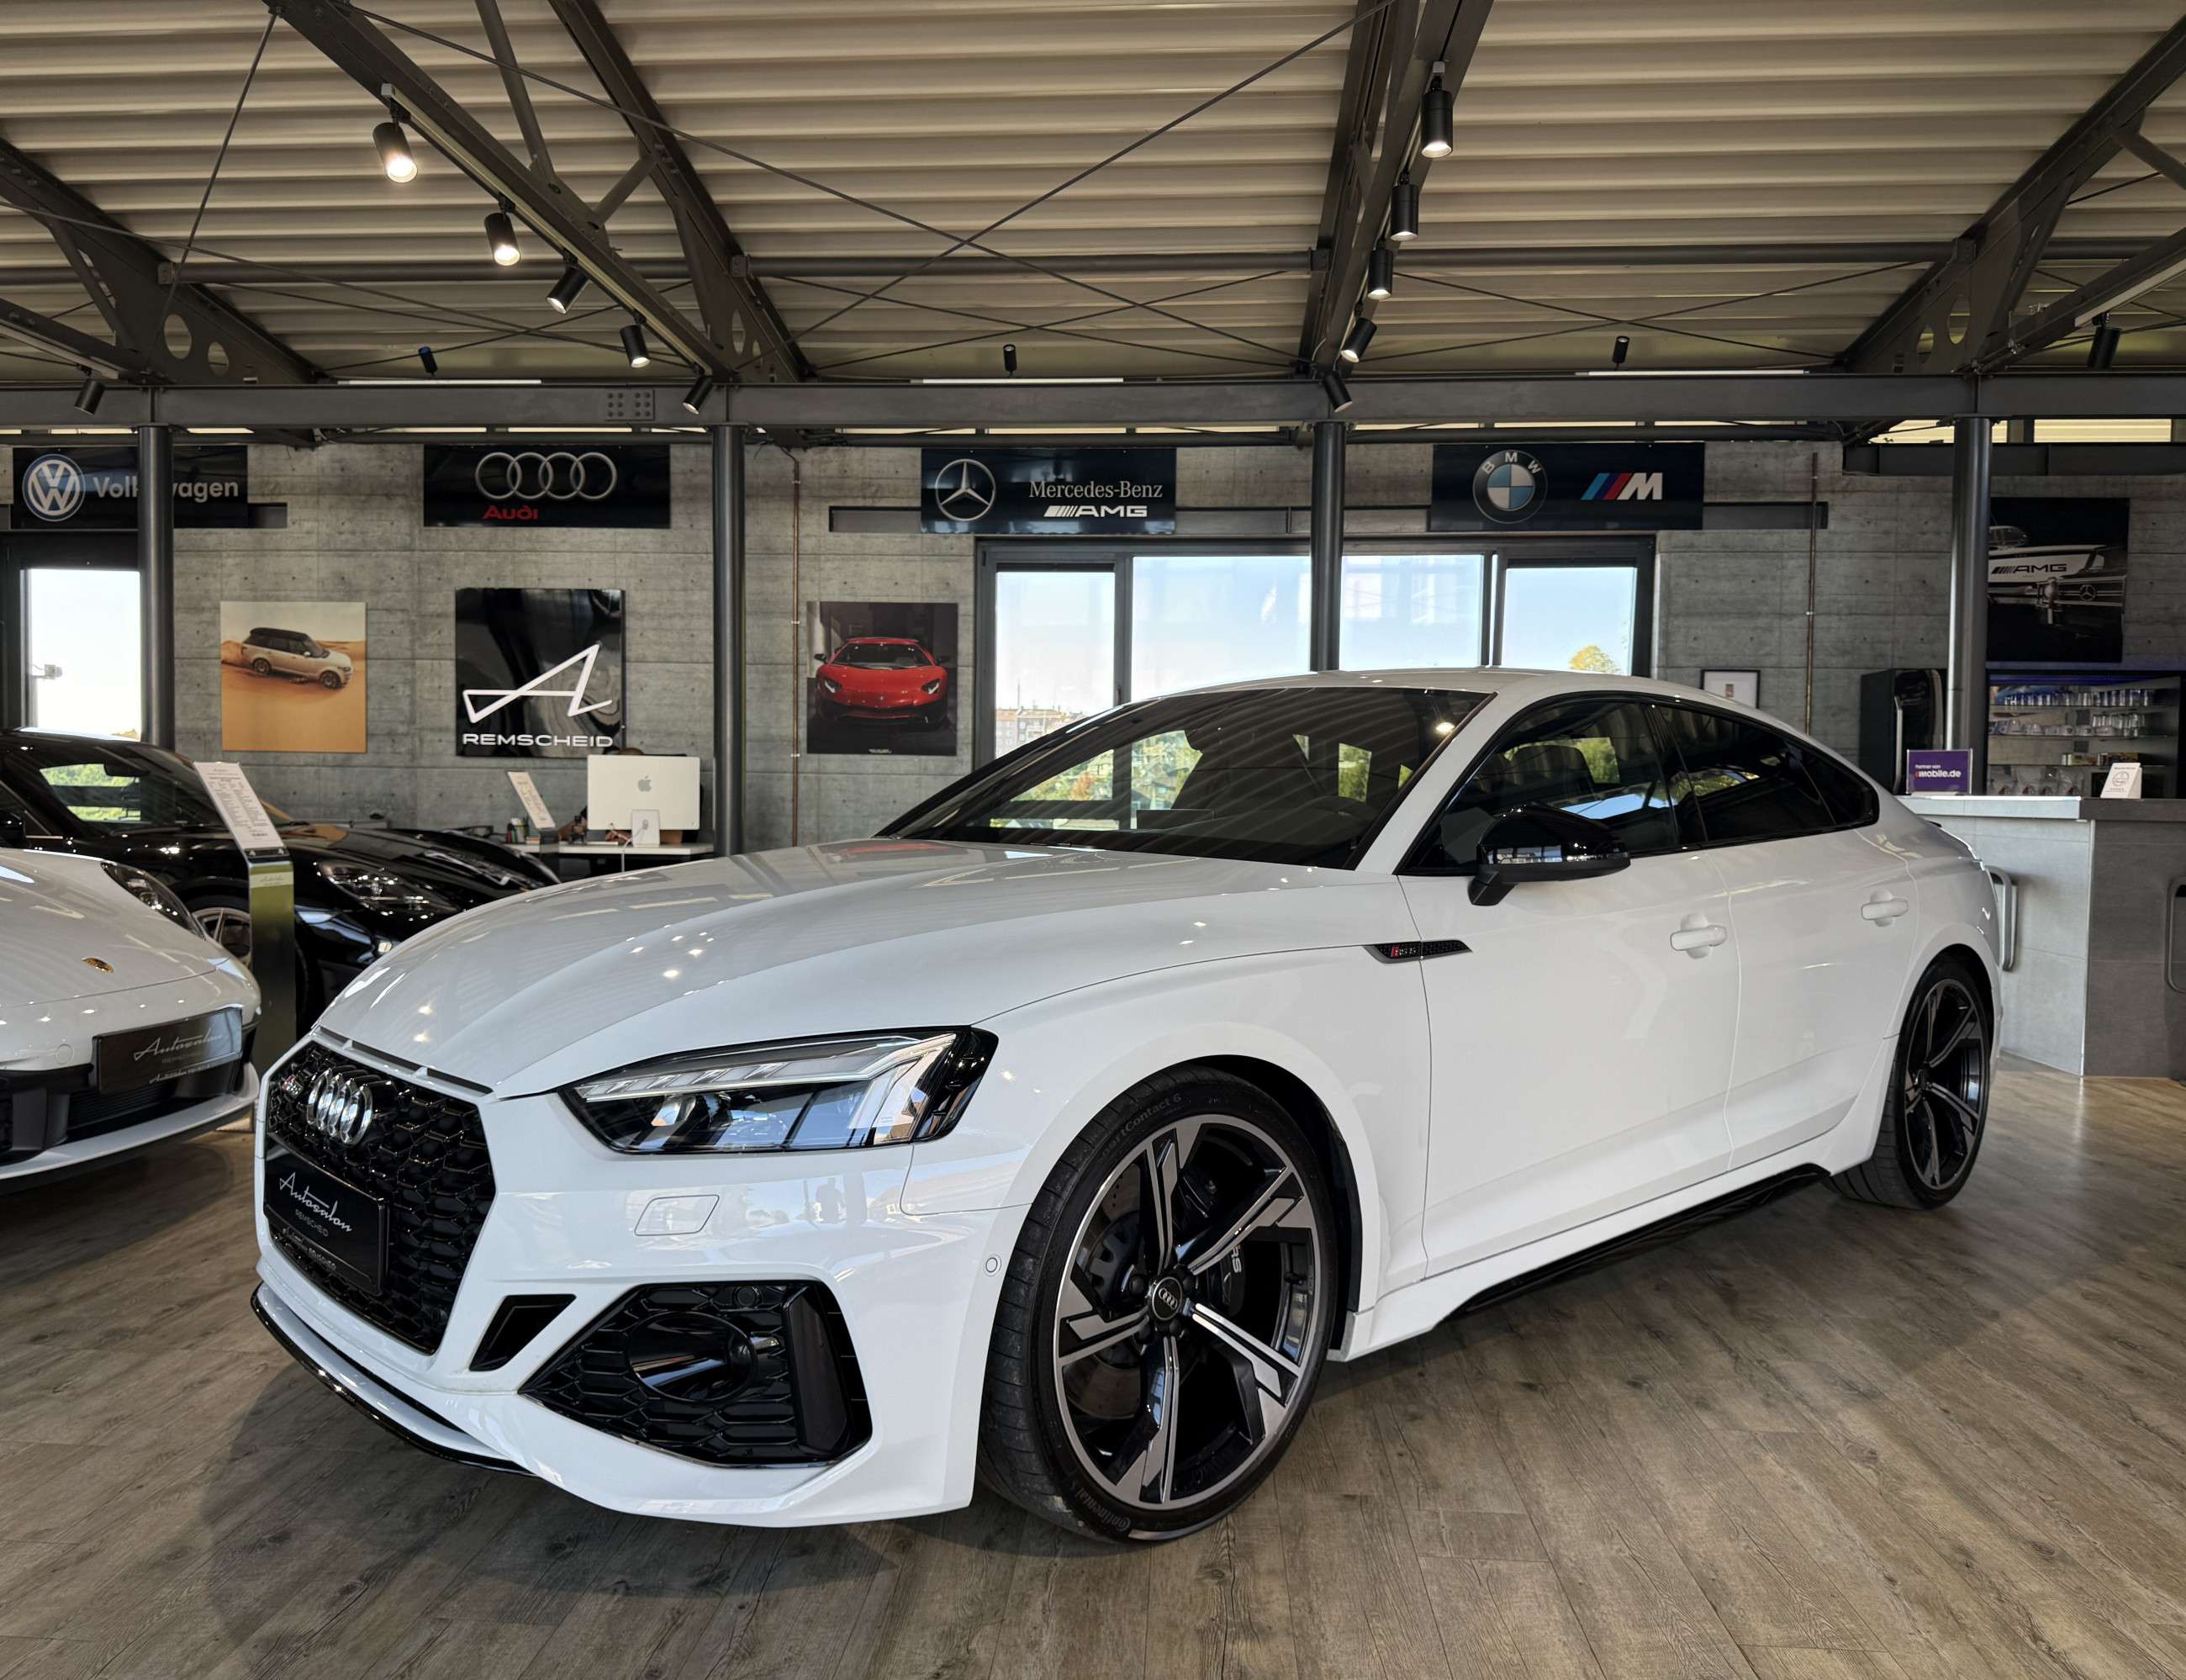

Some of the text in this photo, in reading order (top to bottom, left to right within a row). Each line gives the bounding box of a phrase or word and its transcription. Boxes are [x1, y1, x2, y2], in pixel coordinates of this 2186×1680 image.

[92, 476, 239, 503] Volagen
[1029, 480, 1163, 498] Mercedes-Benz
[483, 505, 539, 520] Audi
[1075, 505, 1148, 518] AMG
[2013, 563, 2067, 573] AMG
[462, 732, 614, 748] REMSCHEID
[1918, 769, 1962, 778] mobile.de
[1097, 1096, 1171, 1164] portContact
